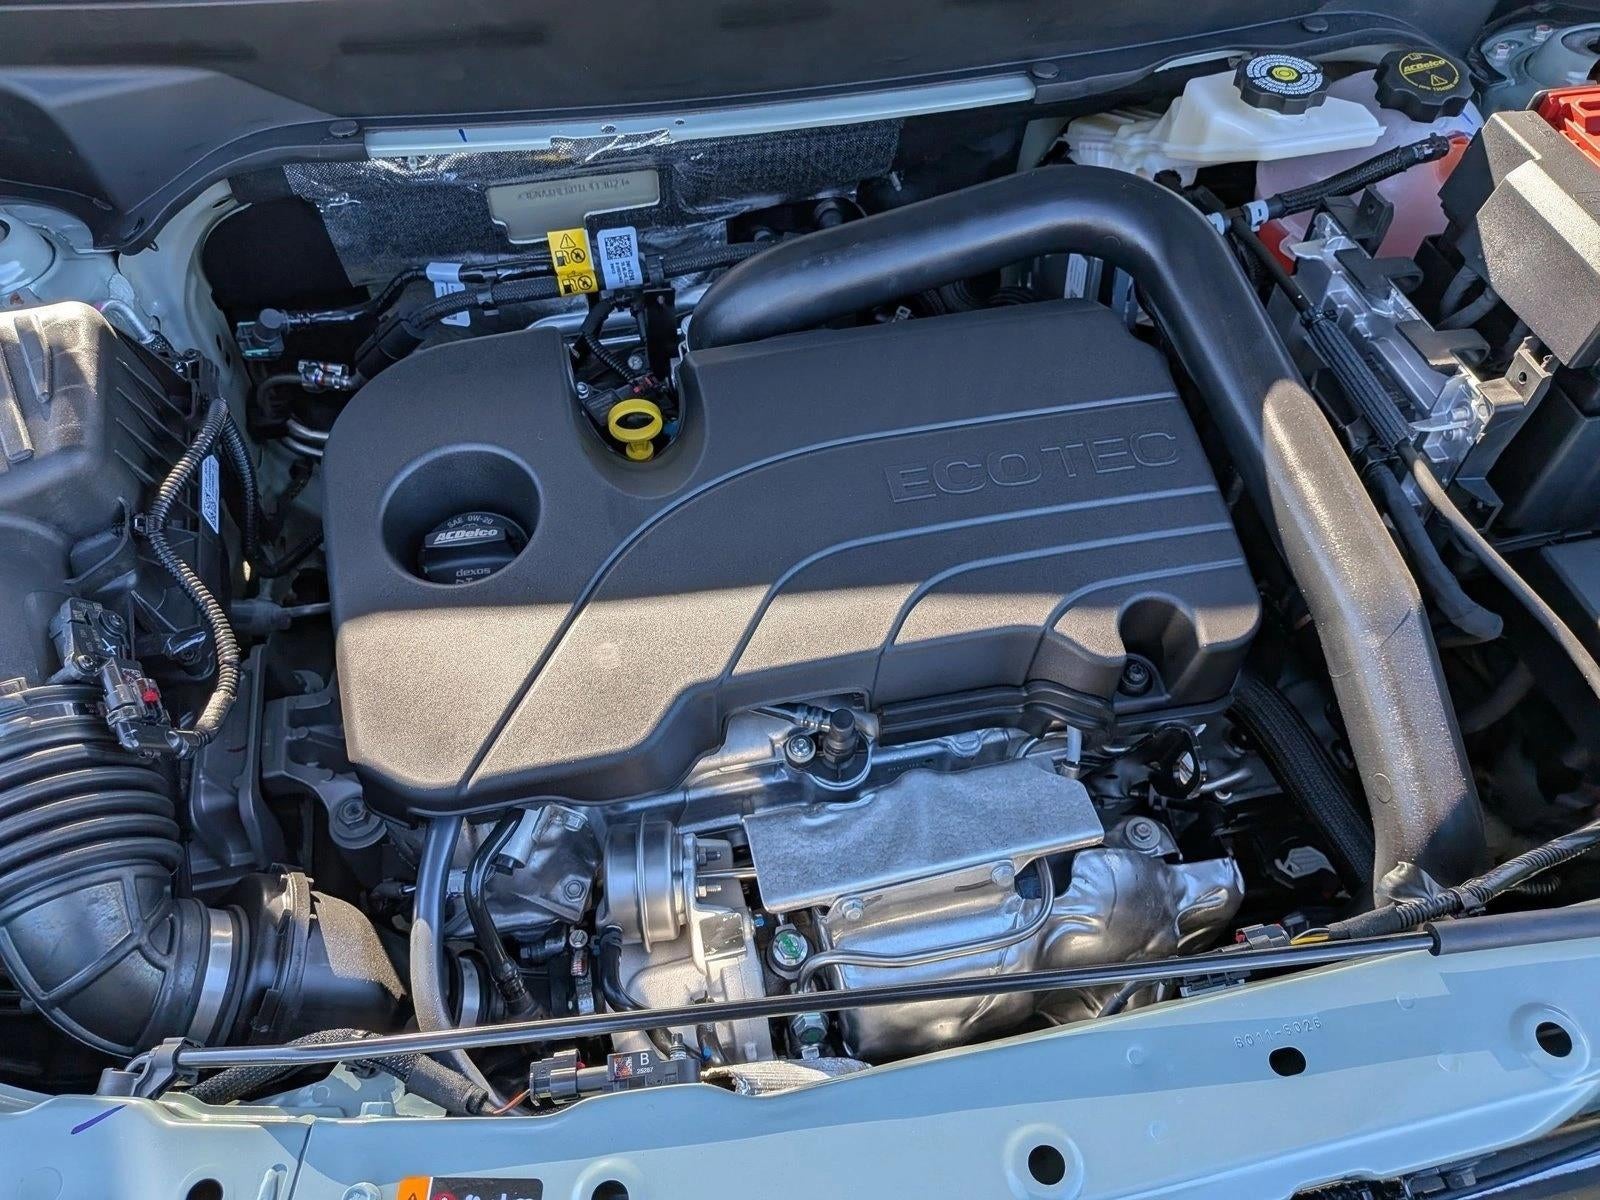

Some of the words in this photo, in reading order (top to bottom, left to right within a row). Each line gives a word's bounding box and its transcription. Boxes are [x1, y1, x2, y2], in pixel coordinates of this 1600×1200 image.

[1403, 60, 1446, 75] ACDelco
[884, 432, 1180, 503] ECOTEC
[447, 516, 464, 528] SAE
[467, 514, 494, 525] 0W-20
[433, 528, 498, 545] ACDelco
[456, 567, 491, 577] dexos
[640, 1052, 650, 1066] B
